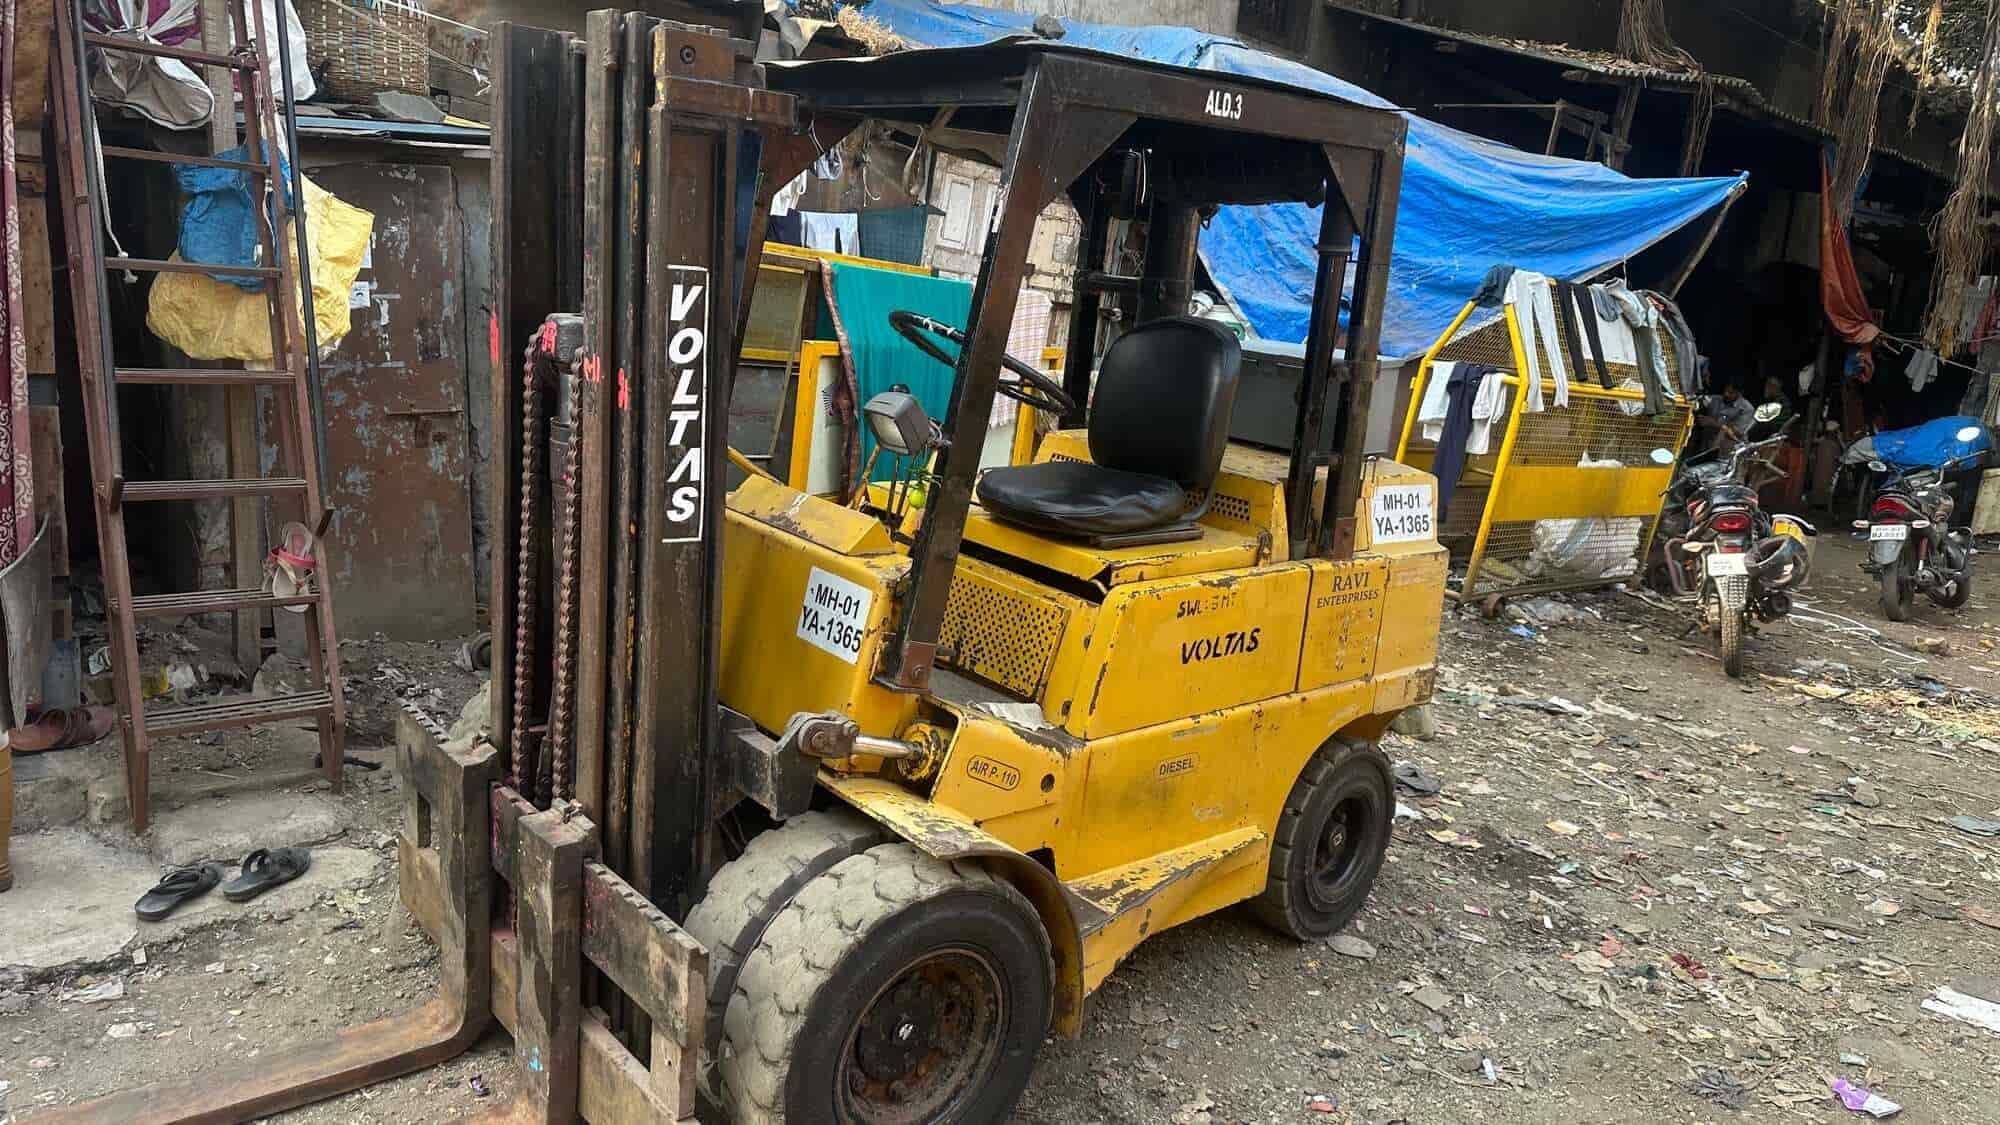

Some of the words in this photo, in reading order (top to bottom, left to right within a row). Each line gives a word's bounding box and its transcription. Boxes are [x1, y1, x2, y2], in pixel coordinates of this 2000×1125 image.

[666, 284, 704, 522] VOLTAS
[1383, 492, 1421, 511] MH-01
[1375, 514, 1430, 535] YA-1365
[1332, 572, 1369, 592] RAVI
[815, 583, 860, 619] MH-01
[1316, 590, 1379, 608] ENTERPRISES
[801, 606, 863, 653] YA-1365
[1181, 627, 1261, 665] VOLTAS
[970, 759, 989, 777] AIR
[1159, 757, 1194, 776] DIESEL
